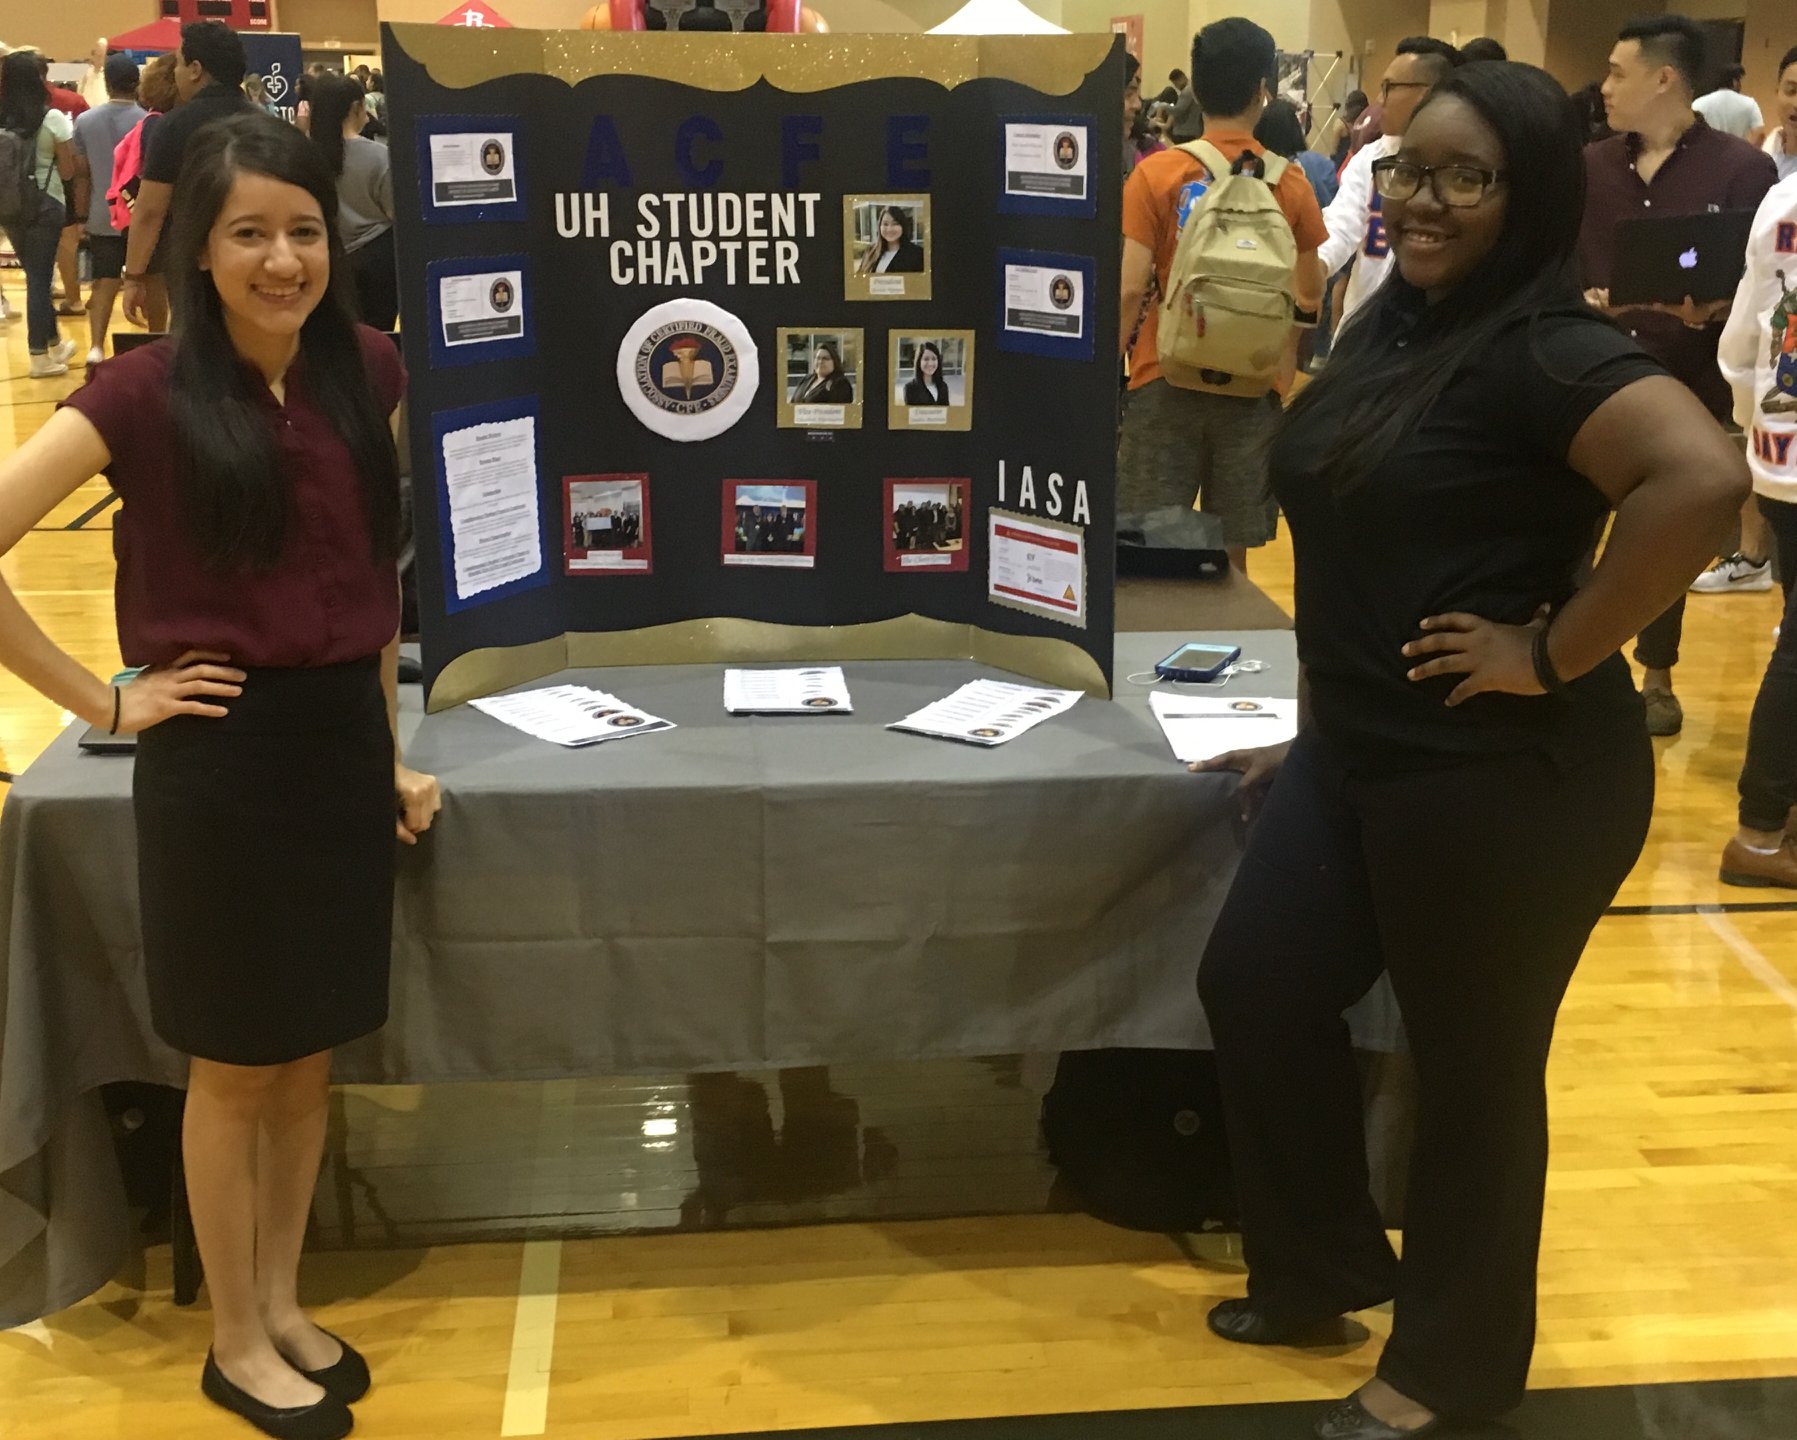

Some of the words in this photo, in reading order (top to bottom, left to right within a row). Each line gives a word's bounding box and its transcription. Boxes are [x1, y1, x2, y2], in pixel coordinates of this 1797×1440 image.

[555, 193, 609, 238] UH
[637, 193, 820, 238] STUDENT
[610, 240, 800, 285] CHAPTER
[651, 321, 703, 342] CERTIFIED
